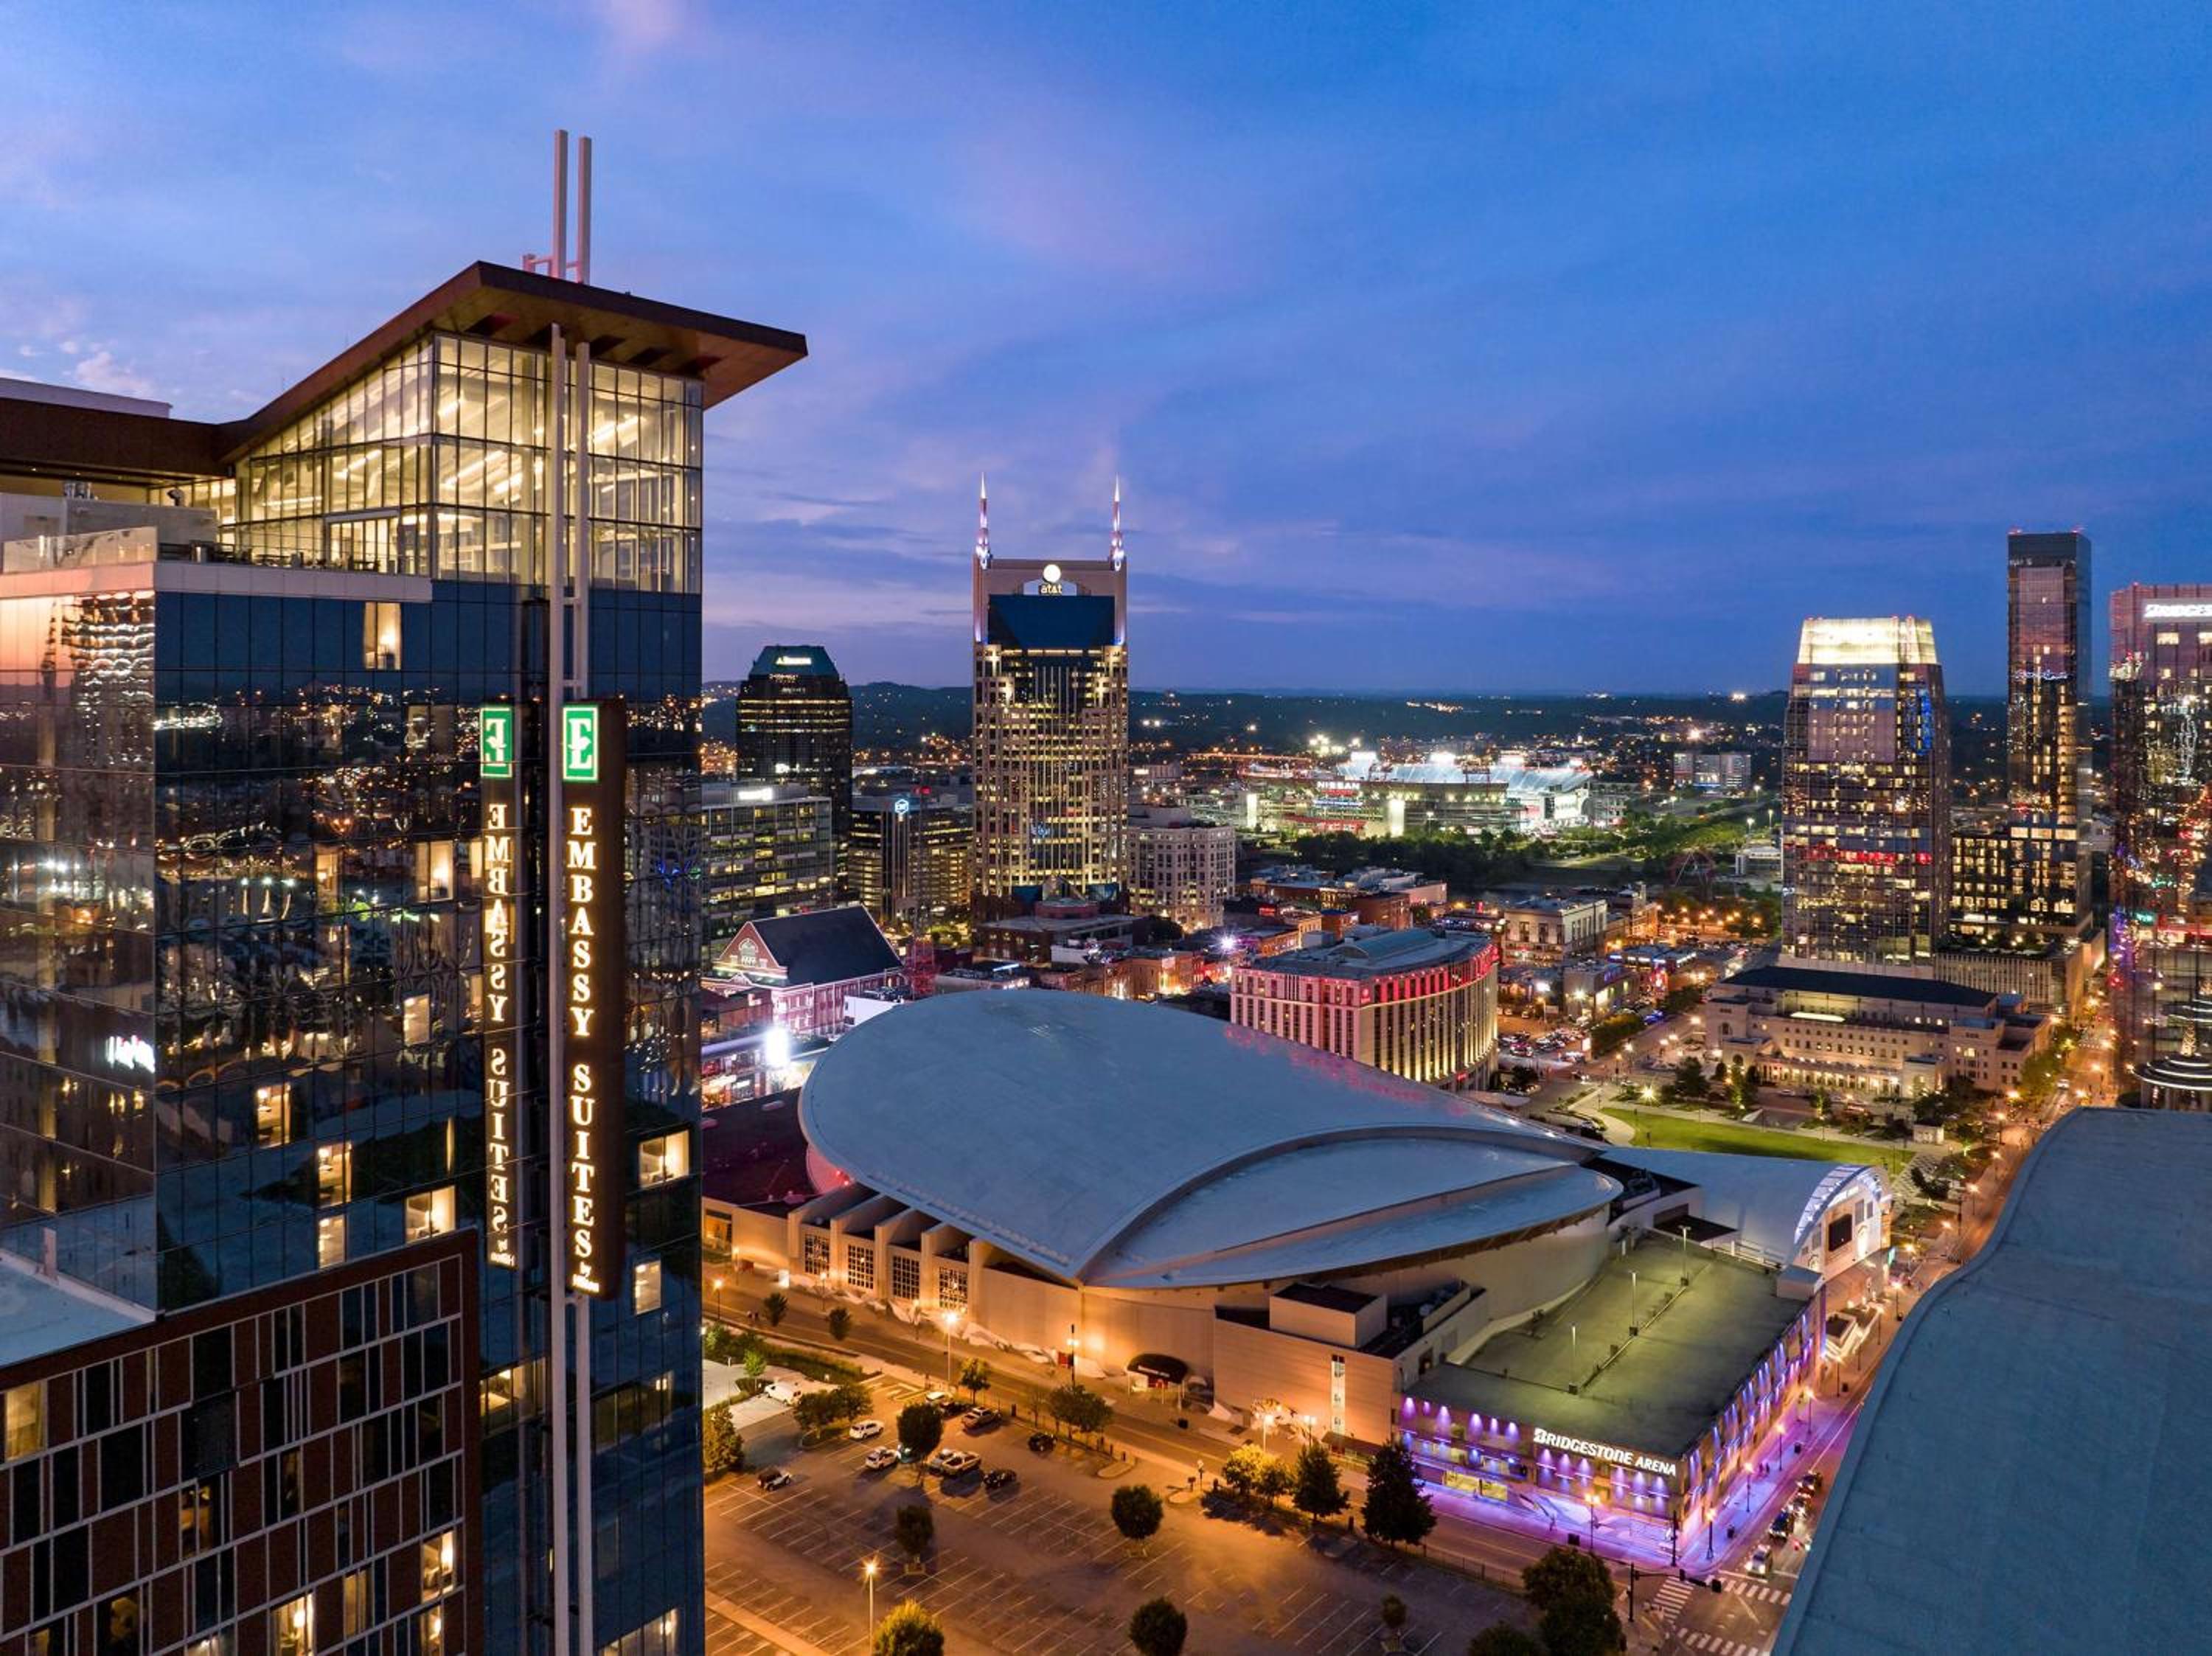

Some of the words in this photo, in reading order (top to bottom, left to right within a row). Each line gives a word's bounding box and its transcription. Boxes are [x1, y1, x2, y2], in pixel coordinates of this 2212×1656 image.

[1316, 780, 1360, 790] NISSAN
[567, 807, 597, 1037] EMBASSY
[571, 1063, 595, 1258] SUITES
[1533, 1427, 1634, 1465] BRIDGESTONE
[1635, 1455, 1677, 1477] ARENA
